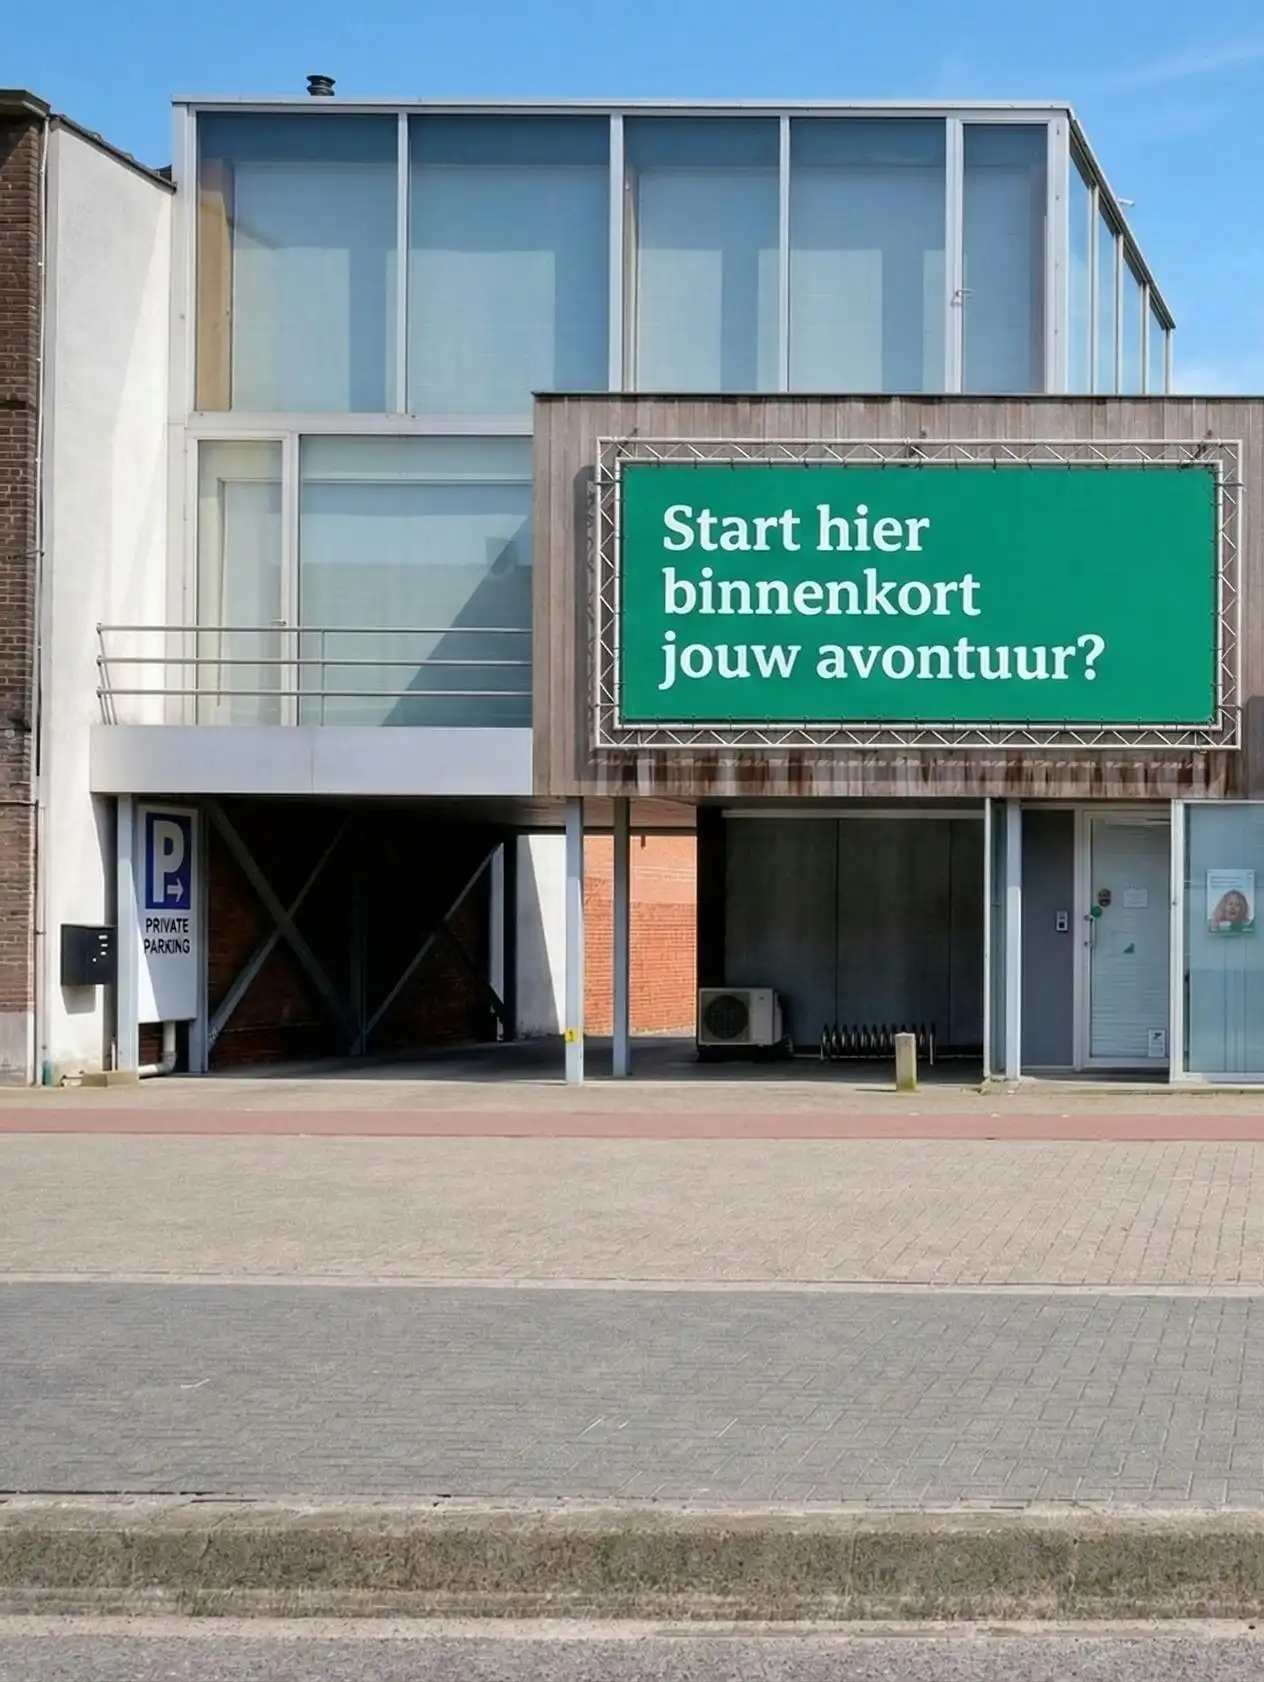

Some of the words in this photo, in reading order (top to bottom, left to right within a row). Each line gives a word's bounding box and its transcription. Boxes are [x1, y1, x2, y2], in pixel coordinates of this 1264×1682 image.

[663, 504, 800, 551] Start
[816, 504, 930, 551] hier
[662, 567, 981, 615] binnenkort
[658, 631, 801, 690] jouw
[816, 634, 1105, 680] avontuur?
[153, 820, 184, 902] P
[144, 939, 191, 954] PARKING
[146, 918, 189, 933] PRIVATE
